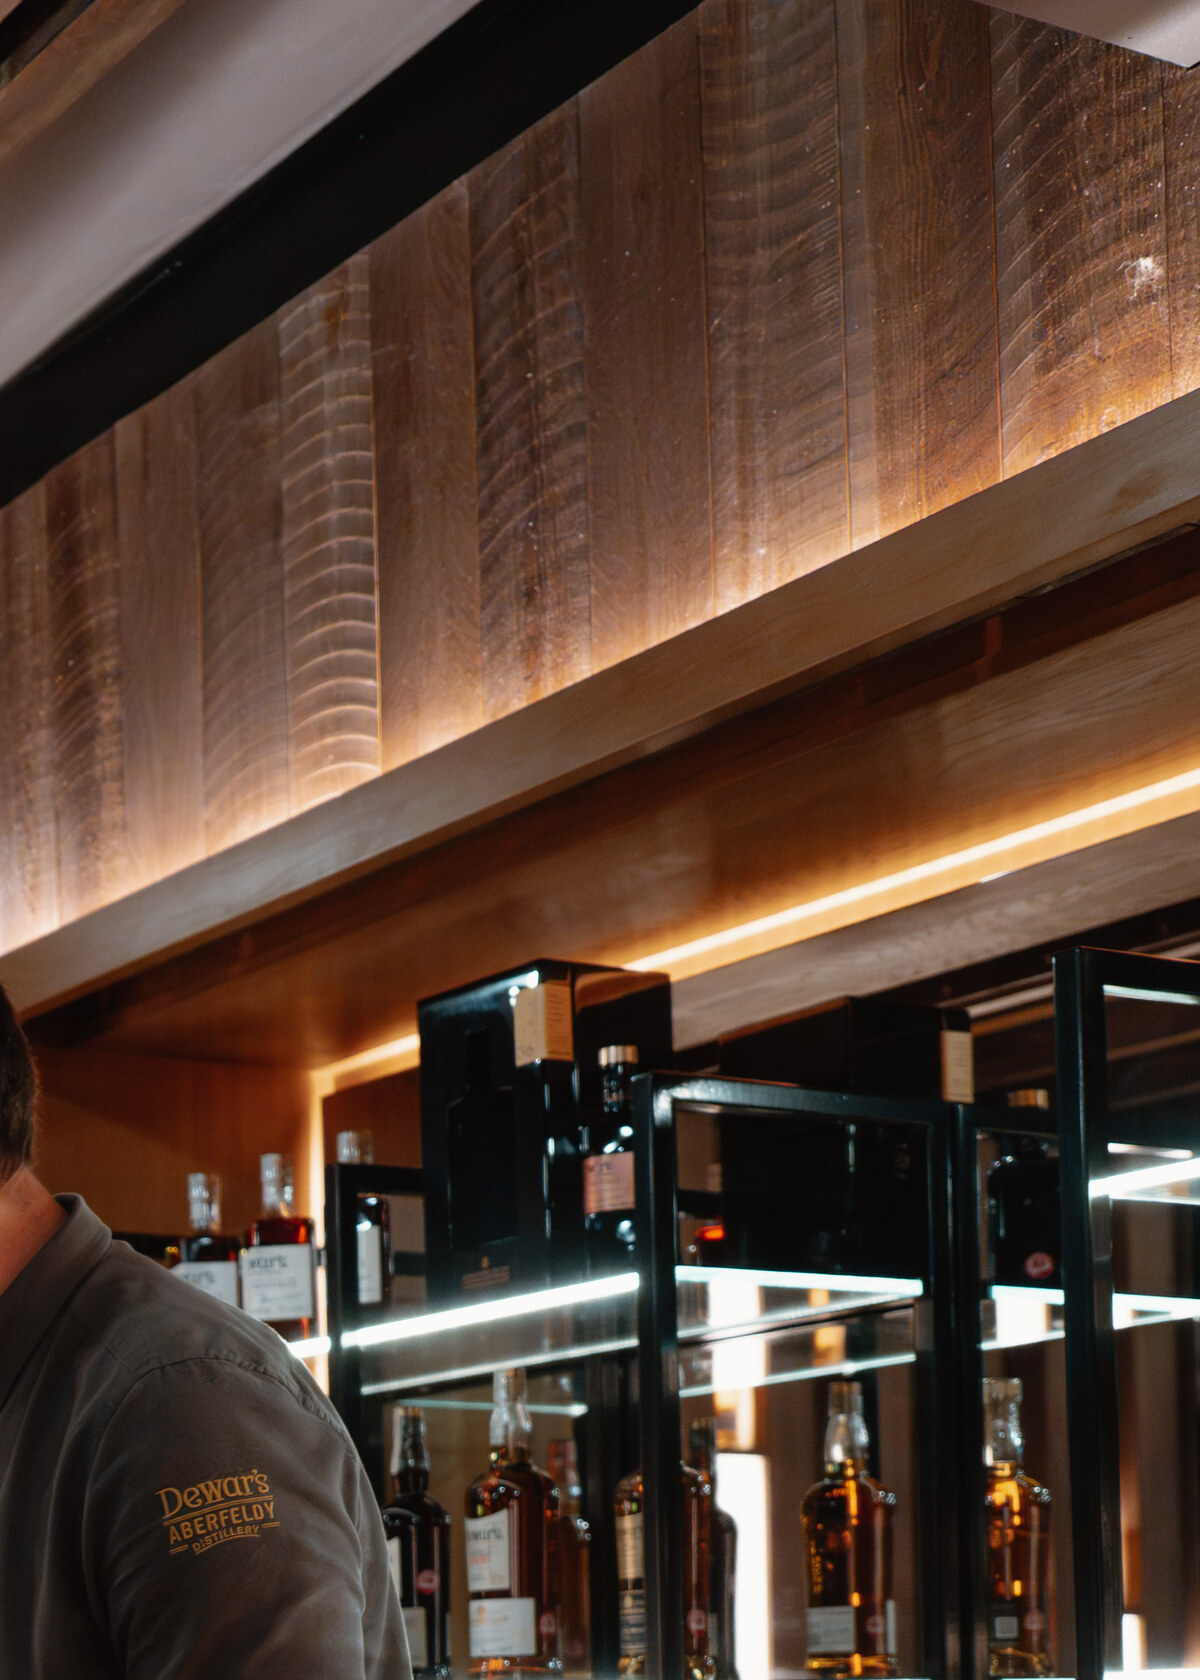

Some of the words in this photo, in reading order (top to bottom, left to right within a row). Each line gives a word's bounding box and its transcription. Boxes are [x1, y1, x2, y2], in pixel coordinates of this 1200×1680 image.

[154, 1469, 270, 1519] Dewar's
[169, 1501, 275, 1545] ABERFELDY
[191, 1525, 260, 1553] DISTILLERY
